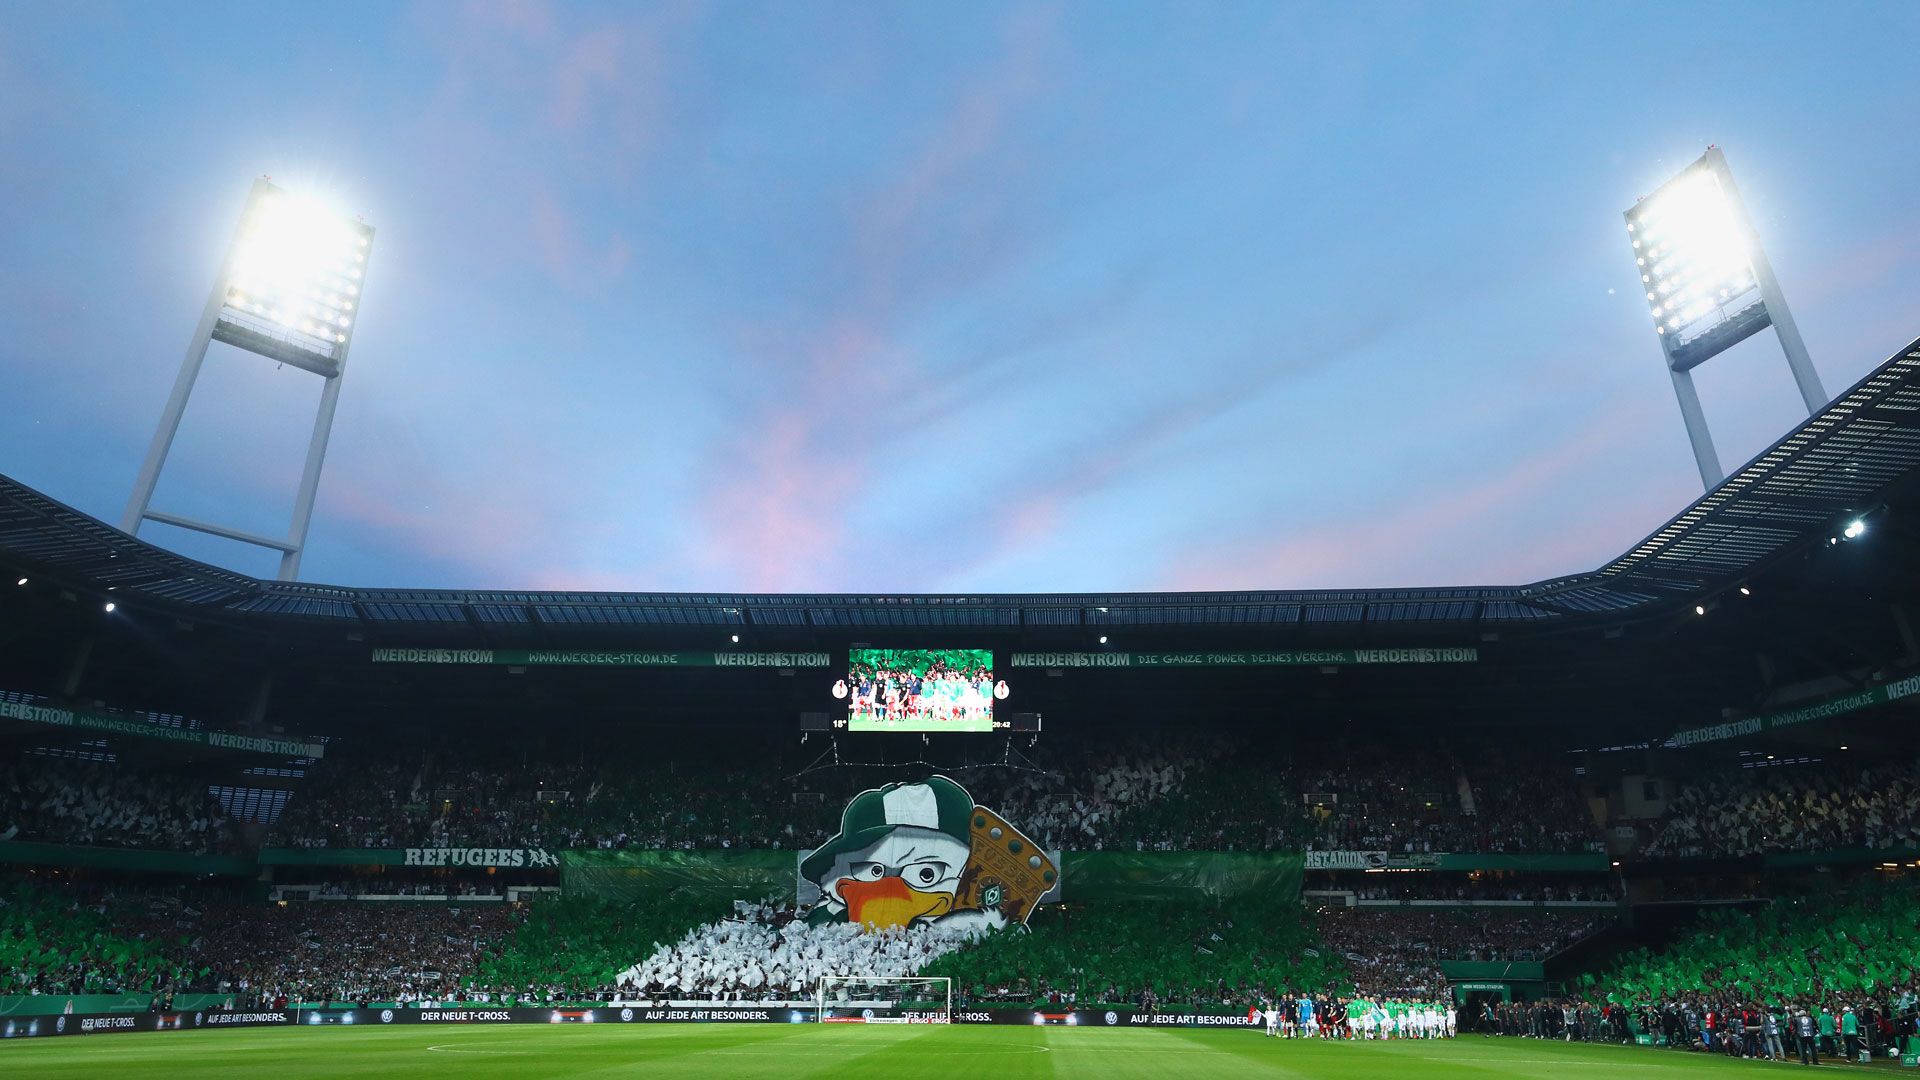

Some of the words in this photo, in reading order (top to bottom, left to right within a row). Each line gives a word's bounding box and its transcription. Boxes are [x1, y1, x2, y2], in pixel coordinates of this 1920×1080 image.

[1138, 655, 1158, 664] DIE
[1162, 654, 1202, 664] GANZE
[1207, 654, 1246, 664] POWER
[1251, 653, 1291, 664] DEINES
[404, 847, 524, 867] REFUGEES
[1305, 850, 1365, 867] RSTADION
[207, 1014, 219, 1024] AUF
[218, 1014, 232, 1024] JEDE
[231, 1013, 241, 1023] ART
[421, 1011, 440, 1021] DER
[442, 1011, 467, 1021] NEUE
[469, 1011, 511, 1021] T-CROSS.
[645, 1011, 665, 1020] AUF
[666, 1011, 689, 1020] JEDE
[690, 1011, 710, 1020] ART
[711, 1011, 770, 1020] BESONDERS.
[1130, 1015, 1149, 1024] AUF
[1151, 1015, 1175, 1024] JEDE
[1176, 1015, 1195, 1024] ART
[81, 1018, 94, 1029] DER
[94, 1018, 110, 1029] NEUE
